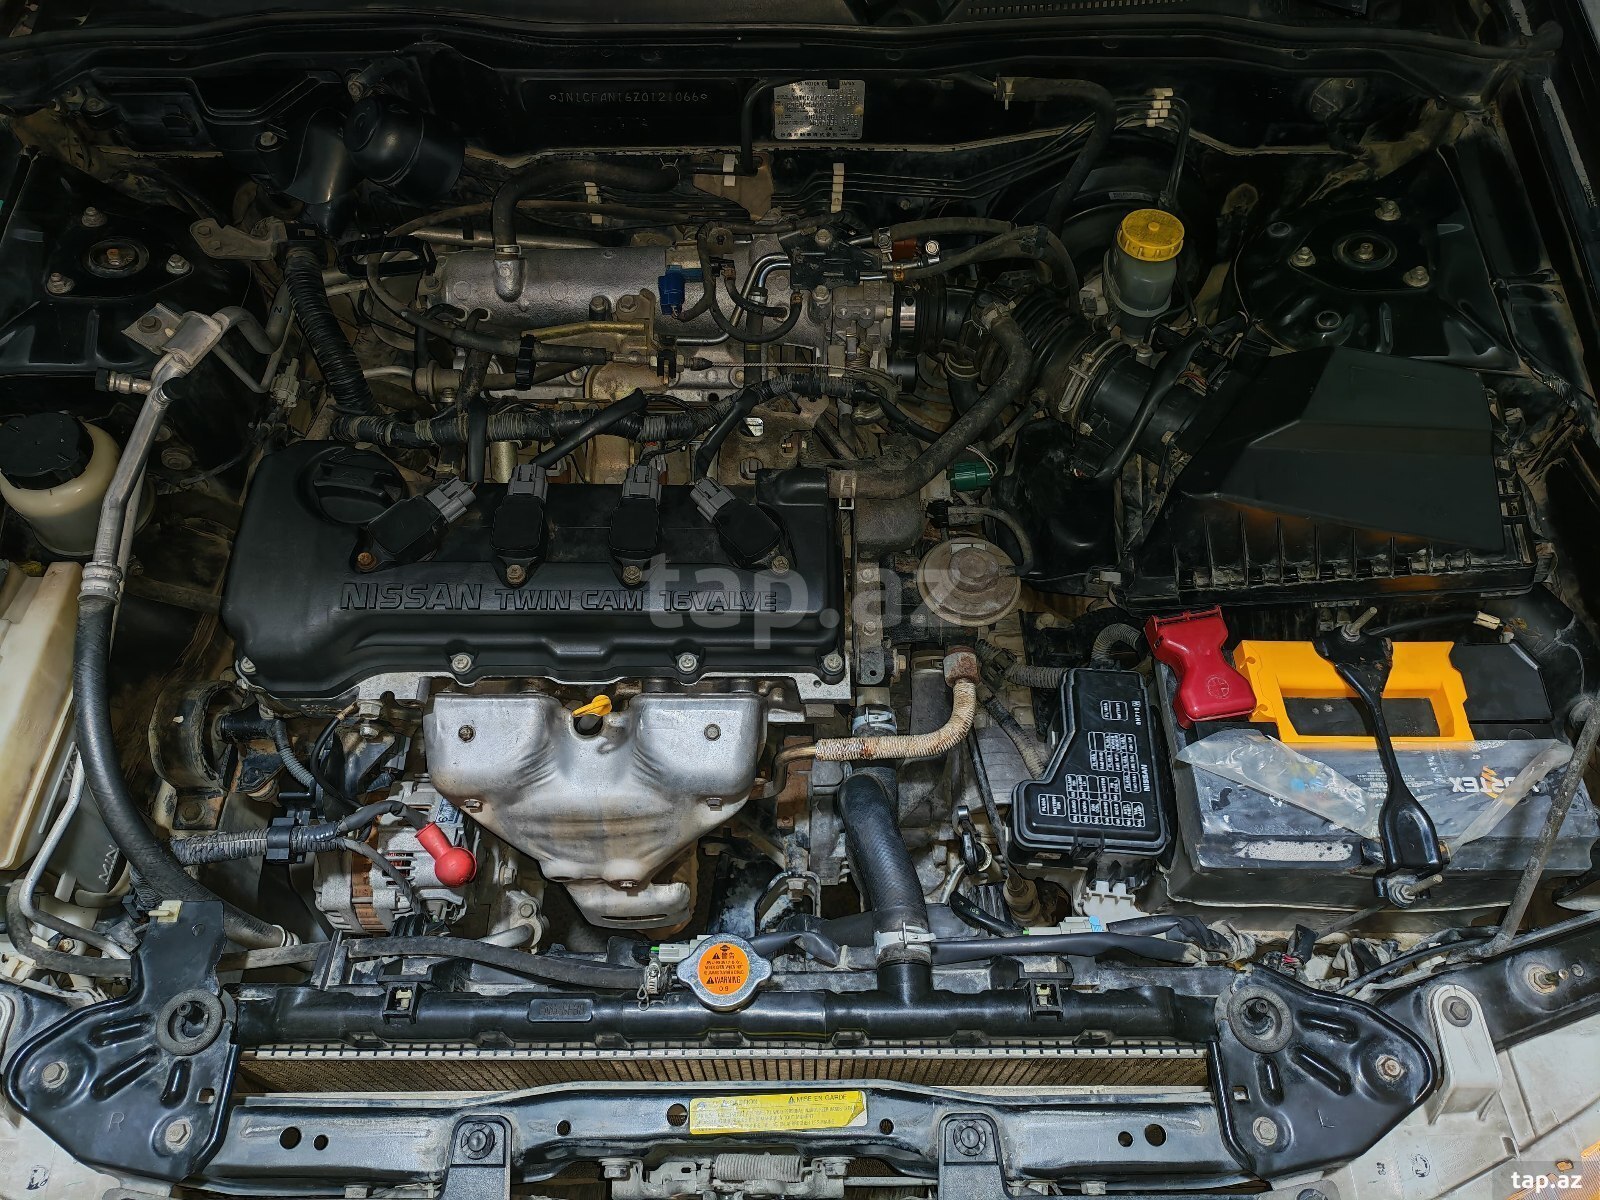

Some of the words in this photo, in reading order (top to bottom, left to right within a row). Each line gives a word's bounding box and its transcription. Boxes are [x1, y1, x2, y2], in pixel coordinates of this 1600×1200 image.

[340, 582, 482, 610] NISSAN
[494, 589, 573, 611] TWIN
[579, 589, 646, 611] CAM
[658, 590, 777, 612] 16VALVE
[1141, 764, 1151, 792] NISSAN
[714, 976, 741, 984] WARNING
